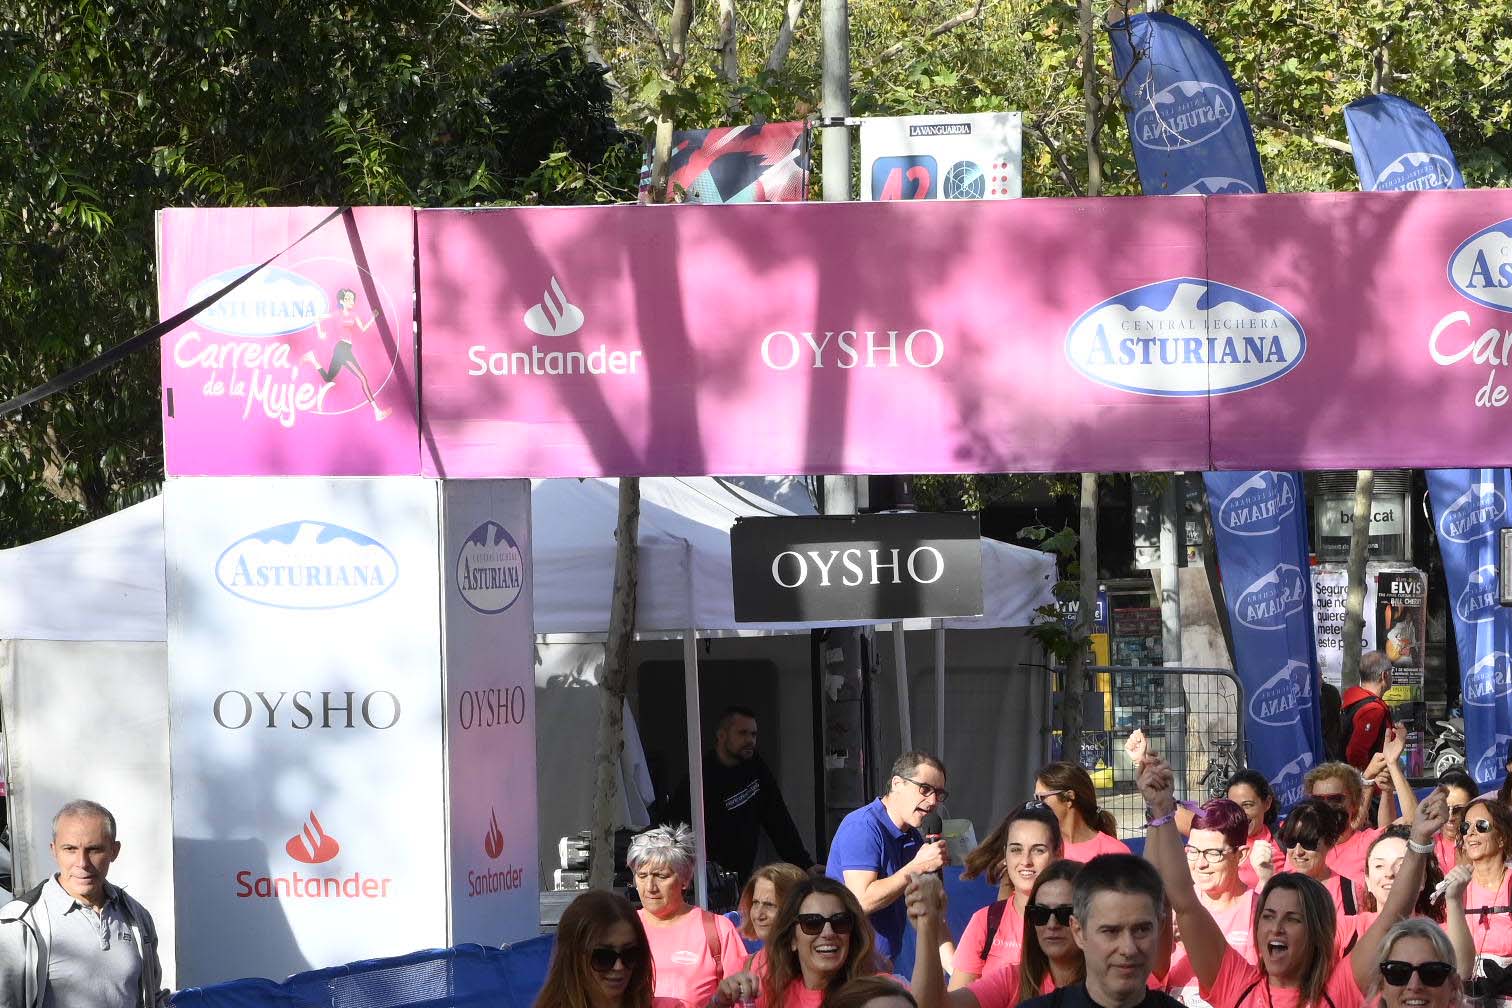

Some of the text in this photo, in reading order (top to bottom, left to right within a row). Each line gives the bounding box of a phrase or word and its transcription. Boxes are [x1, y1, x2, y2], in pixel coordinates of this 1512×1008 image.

[1121, 318, 1280, 332] CENTRAL LECHERA
[174, 331, 290, 370] Carrera
[468, 343, 641, 377] Santander
[761, 329, 944, 371] OYSHO
[1087, 324, 1287, 365] ASTURIANA
[203, 364, 336, 427] de la Mujer
[1475, 369, 1510, 407] de
[230, 554, 385, 587] ASTURIANA
[462, 563, 519, 591] ASTURIANA
[772, 545, 944, 589] OYSHO
[1317, 598, 1333, 609] que
[1391, 582, 1421, 594] ELVIS
[1318, 610, 1348, 622] quiere
[1318, 638, 1336, 648] este
[213, 690, 400, 729] OYSHO
[459, 685, 525, 730] OYSHO
[236, 871, 392, 898] Santander
[468, 866, 523, 897] Santander
